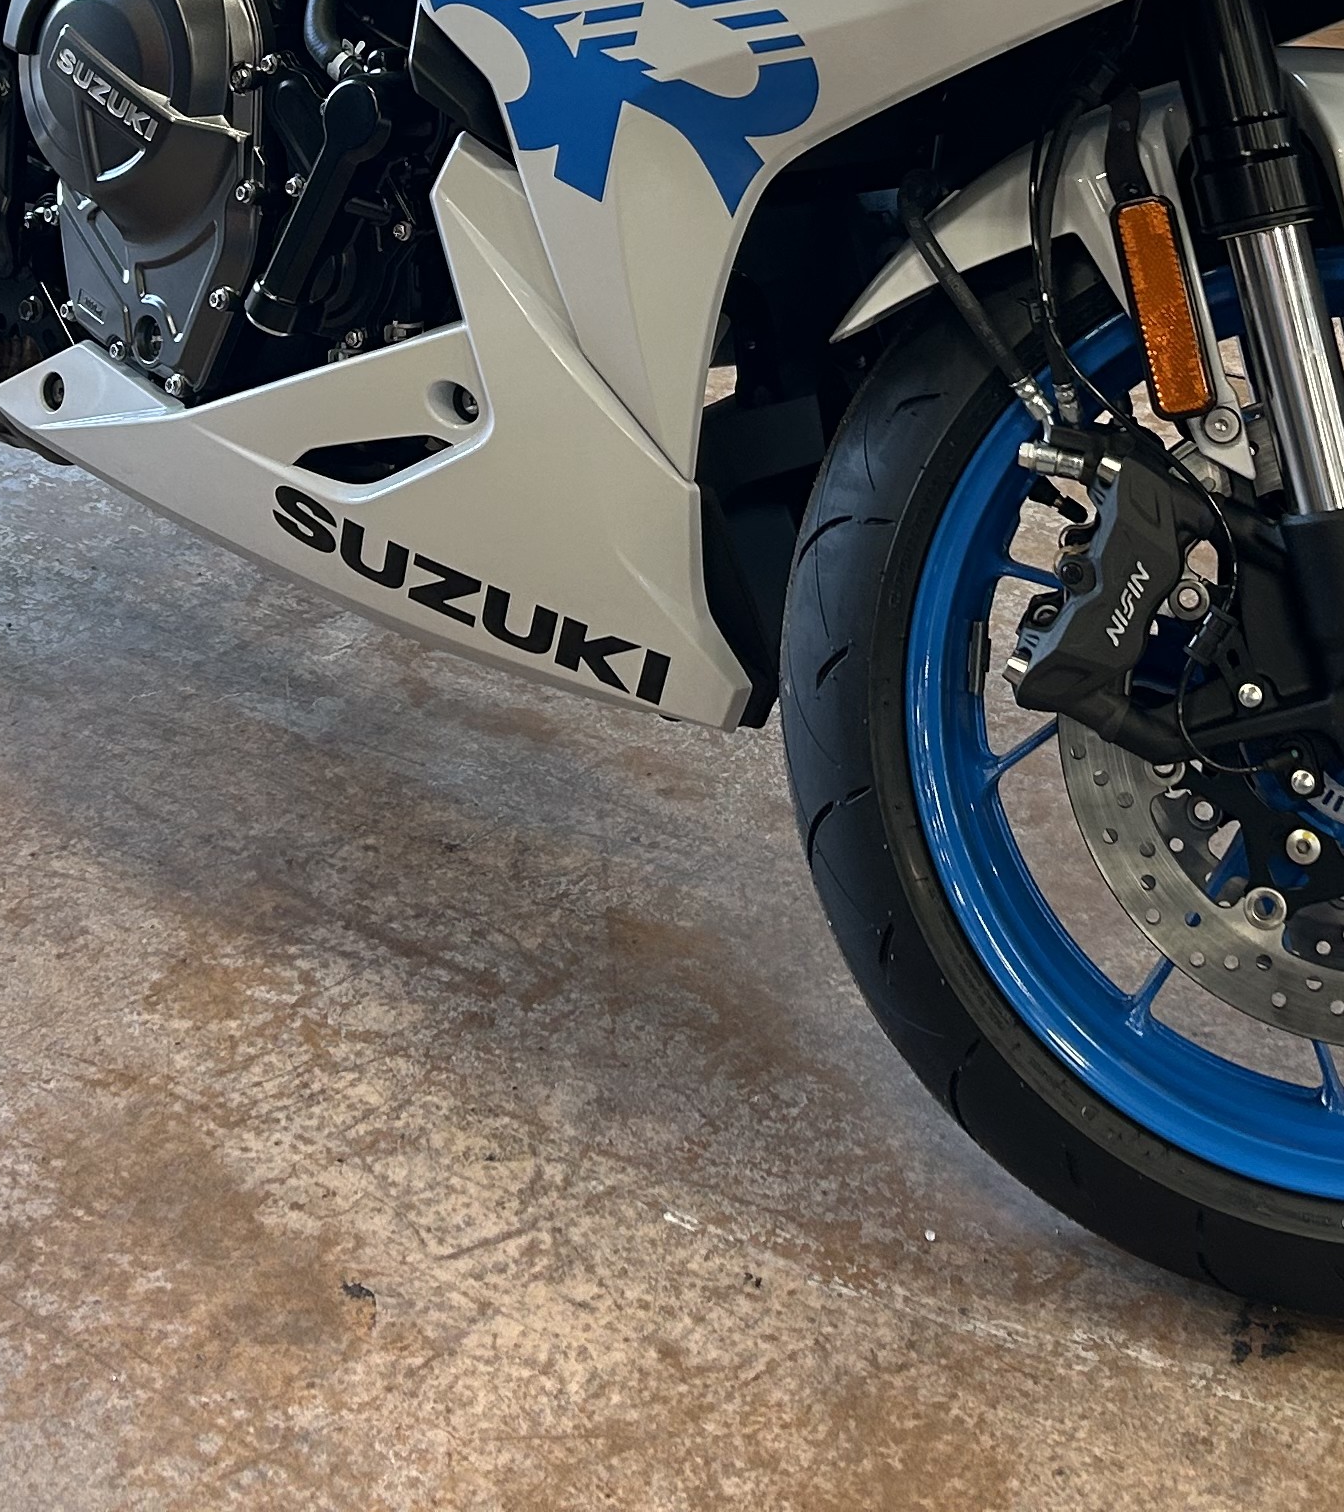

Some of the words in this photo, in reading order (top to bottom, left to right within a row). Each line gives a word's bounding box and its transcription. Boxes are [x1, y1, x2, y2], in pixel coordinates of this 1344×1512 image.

[55, 48, 159, 142] SUZUKI
[272, 485, 672, 706] SUZUKI
[1105, 560, 1150, 648] NISSIN
